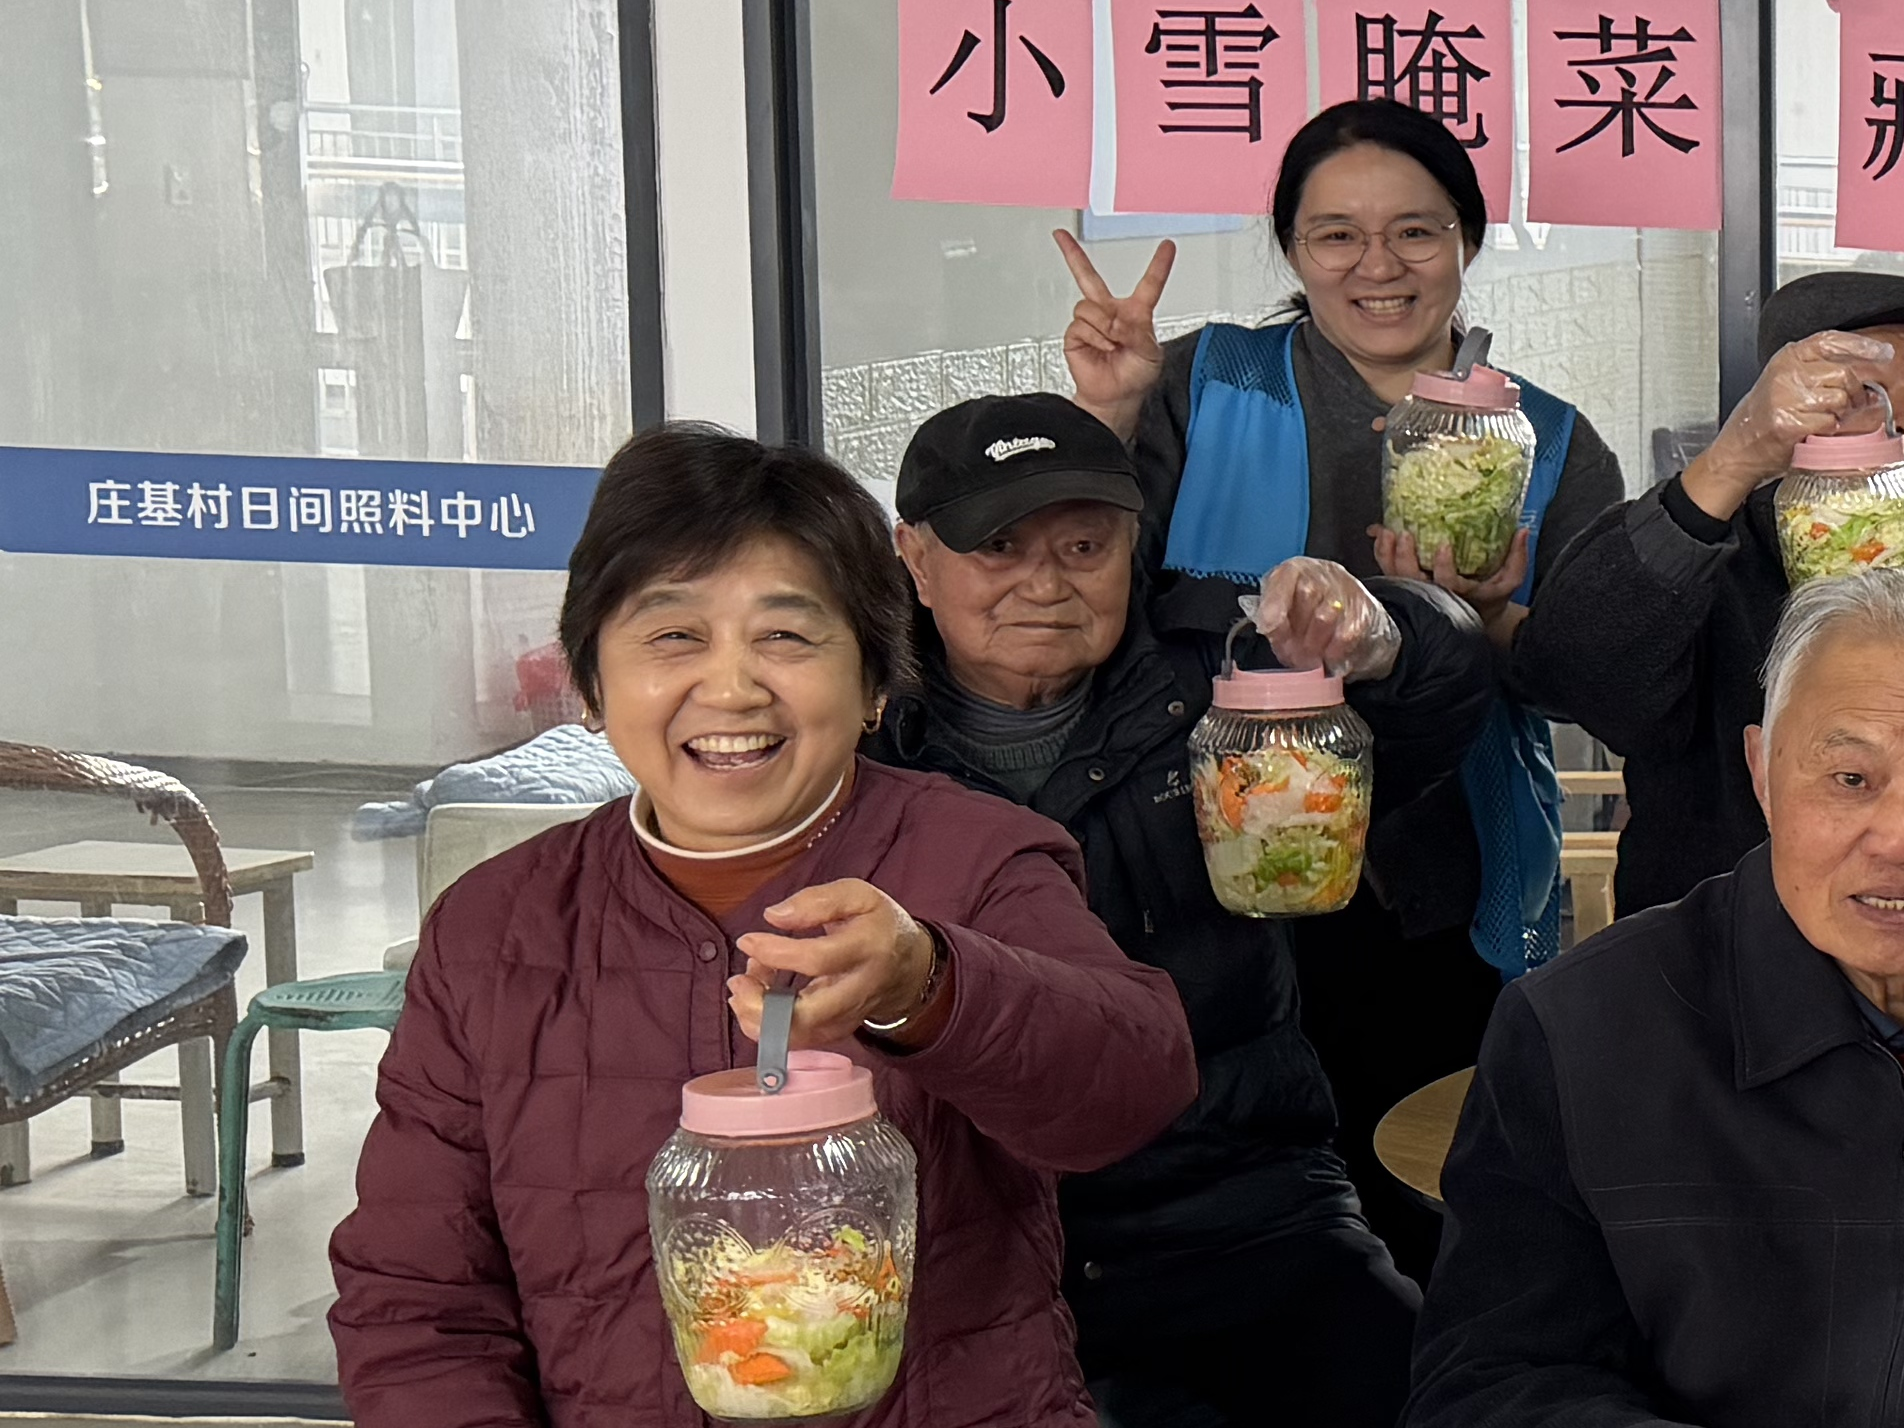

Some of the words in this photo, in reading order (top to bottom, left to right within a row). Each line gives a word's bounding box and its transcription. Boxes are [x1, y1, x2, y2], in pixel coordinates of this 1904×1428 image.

[86, 478, 537, 540] 庄基村日间照料中心
